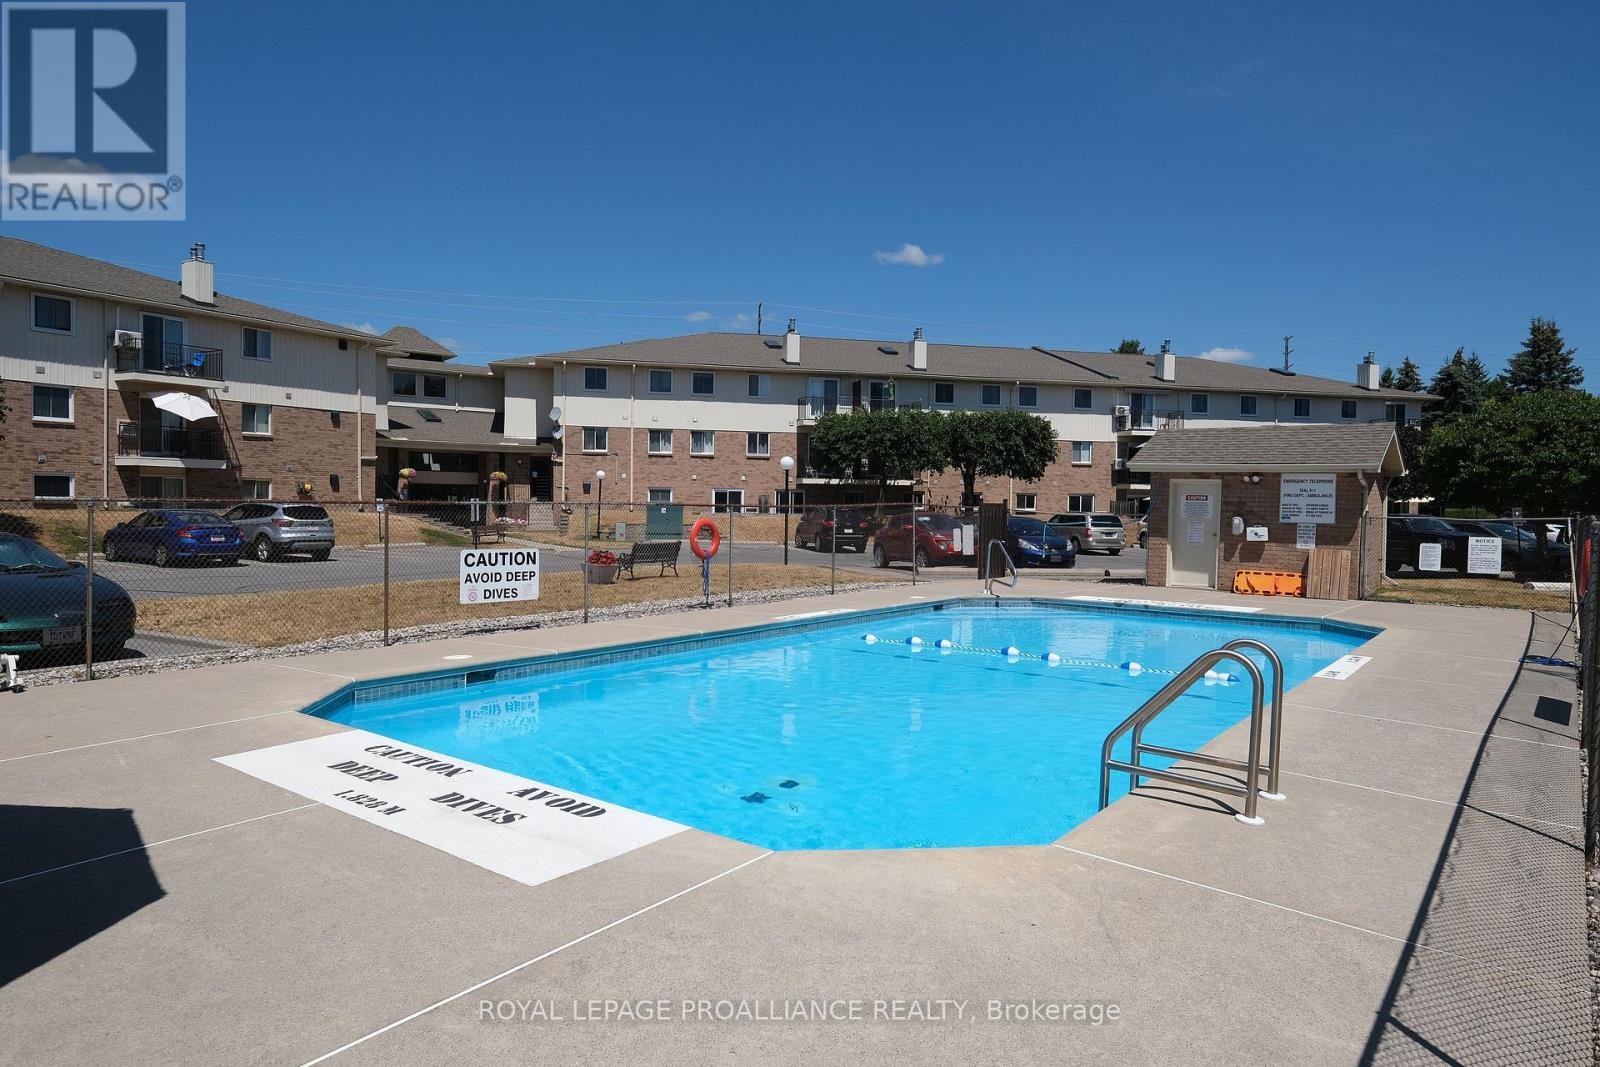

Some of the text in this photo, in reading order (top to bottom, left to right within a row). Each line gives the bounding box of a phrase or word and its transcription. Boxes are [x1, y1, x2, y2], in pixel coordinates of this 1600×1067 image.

[464, 551, 537, 568] CAUTION
[464, 571, 536, 584] AVOID DEEP
[483, 588, 518, 600] DIVES
[364, 744, 607, 818] CAUTION AVOID
[326, 760, 528, 825] DEEP DIVES
[333, 789, 407, 816] 1.828 M
